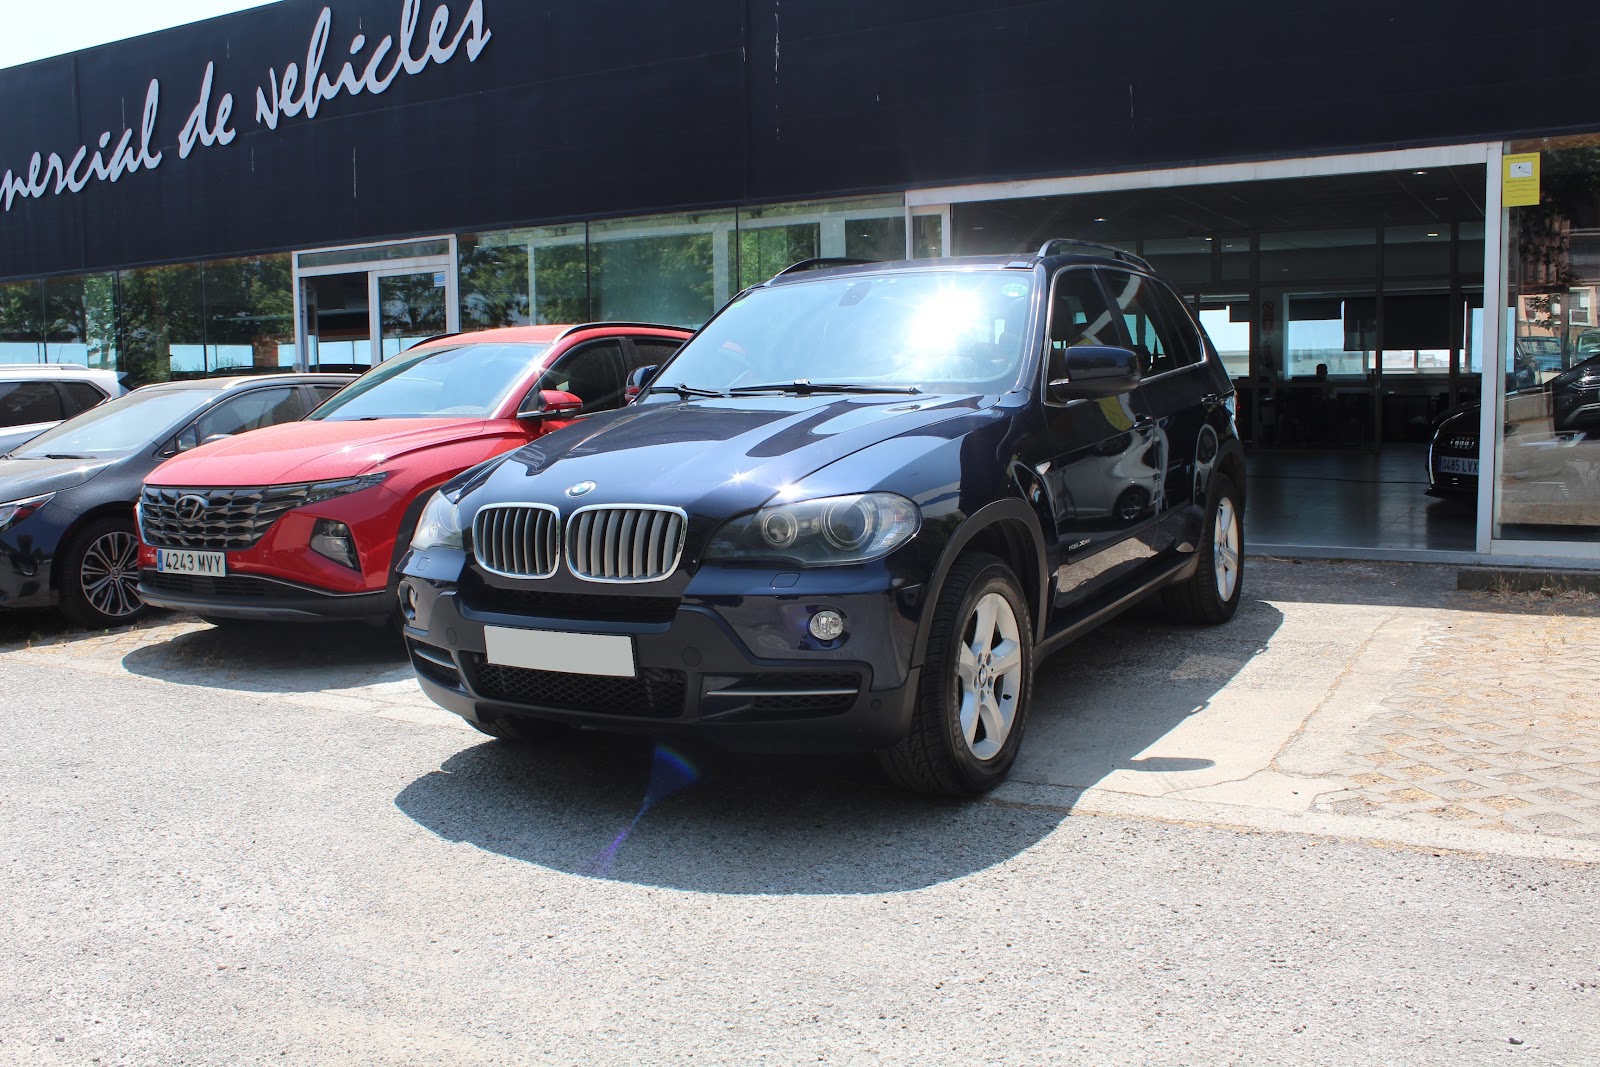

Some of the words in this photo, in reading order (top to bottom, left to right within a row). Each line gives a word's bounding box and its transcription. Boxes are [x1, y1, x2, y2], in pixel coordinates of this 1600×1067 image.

[178, 61, 236, 159] de
[256, 0, 491, 130] vehicles
[1442, 458, 1460, 471] 0485
[165, 552, 194, 571] 4243
[198, 554, 221, 573] MVY
